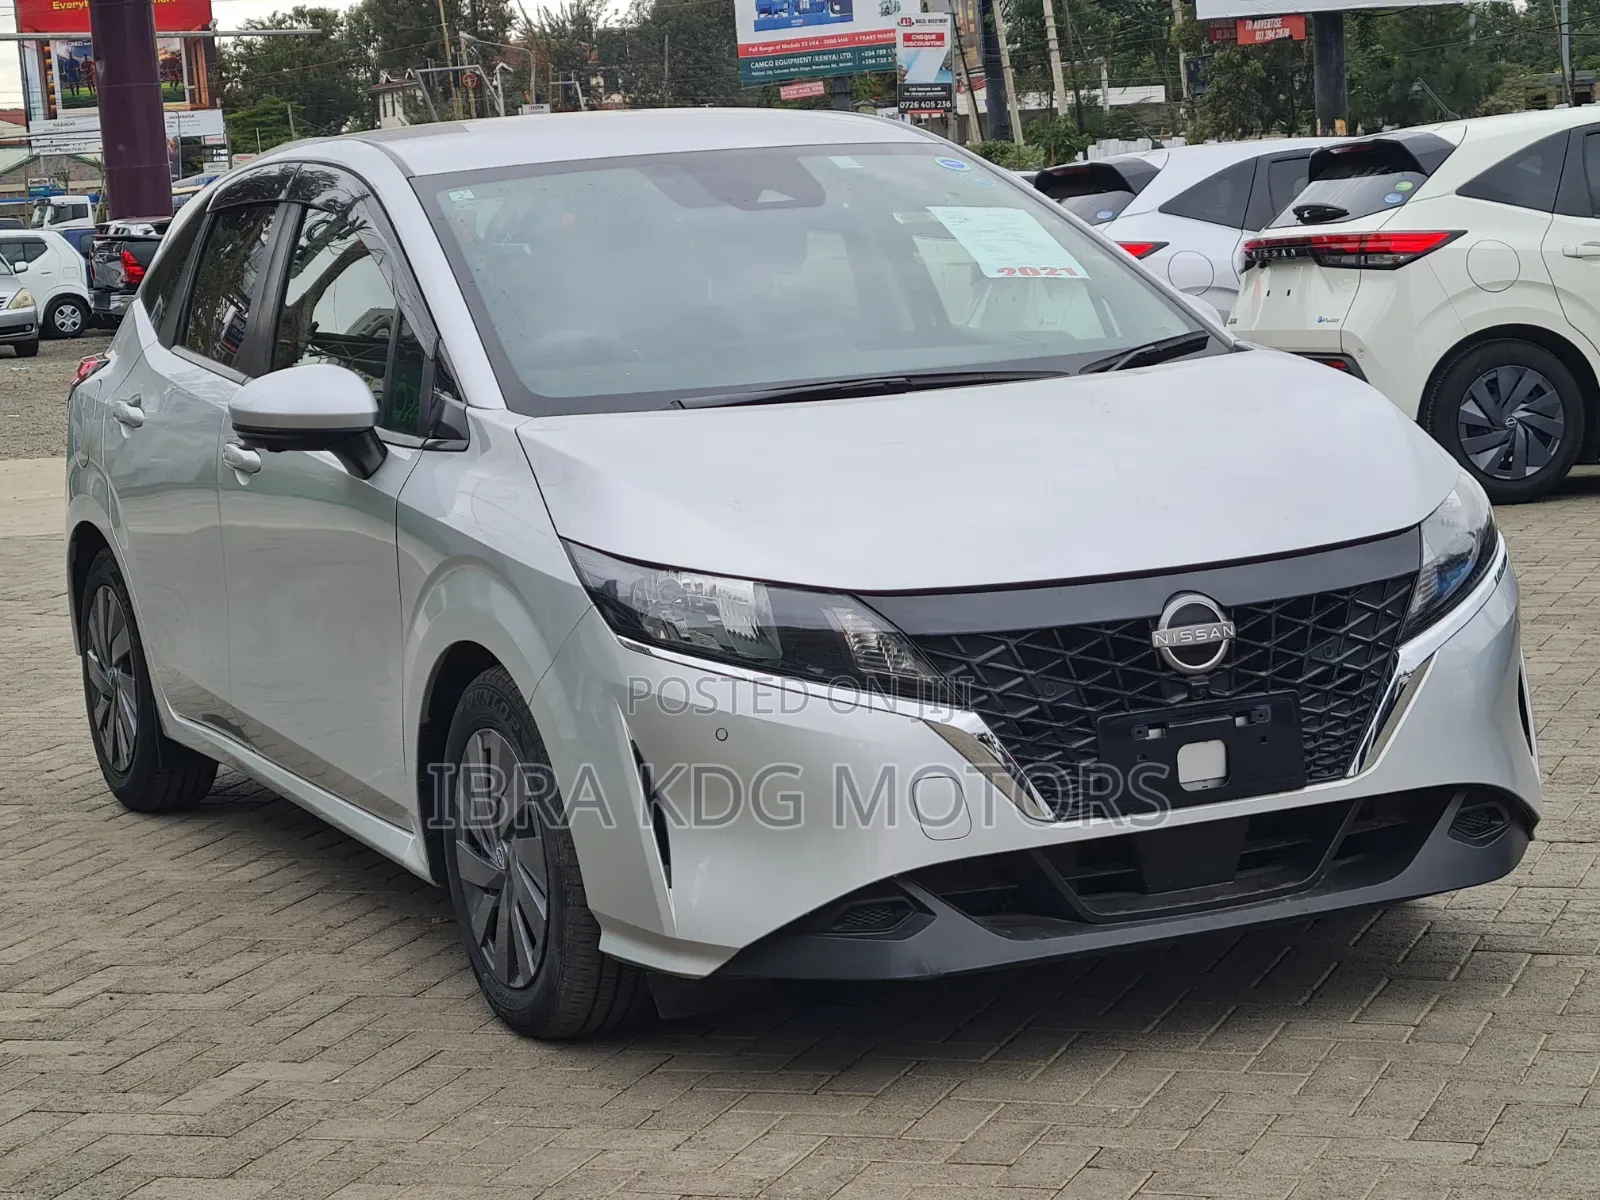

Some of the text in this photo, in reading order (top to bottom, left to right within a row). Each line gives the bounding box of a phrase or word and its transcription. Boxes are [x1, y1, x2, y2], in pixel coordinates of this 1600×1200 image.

[1245, 18, 1283, 30] TO ADVERTISE
[759, 45, 775, 53] Range
[859, 33, 877, 41] YEARS
[750, 52, 853, 69] CAMCO EQUIPMENT (KENYA) LTD.
[899, 101, 919, 109] 0726
[937, 100, 951, 108] 236
[1251, 248, 1297, 259] NISSAN
[996, 266, 1078, 277] 2021
[1154, 624, 1234, 645] NISSAN
[466, 688, 520, 731] DUNLOP
